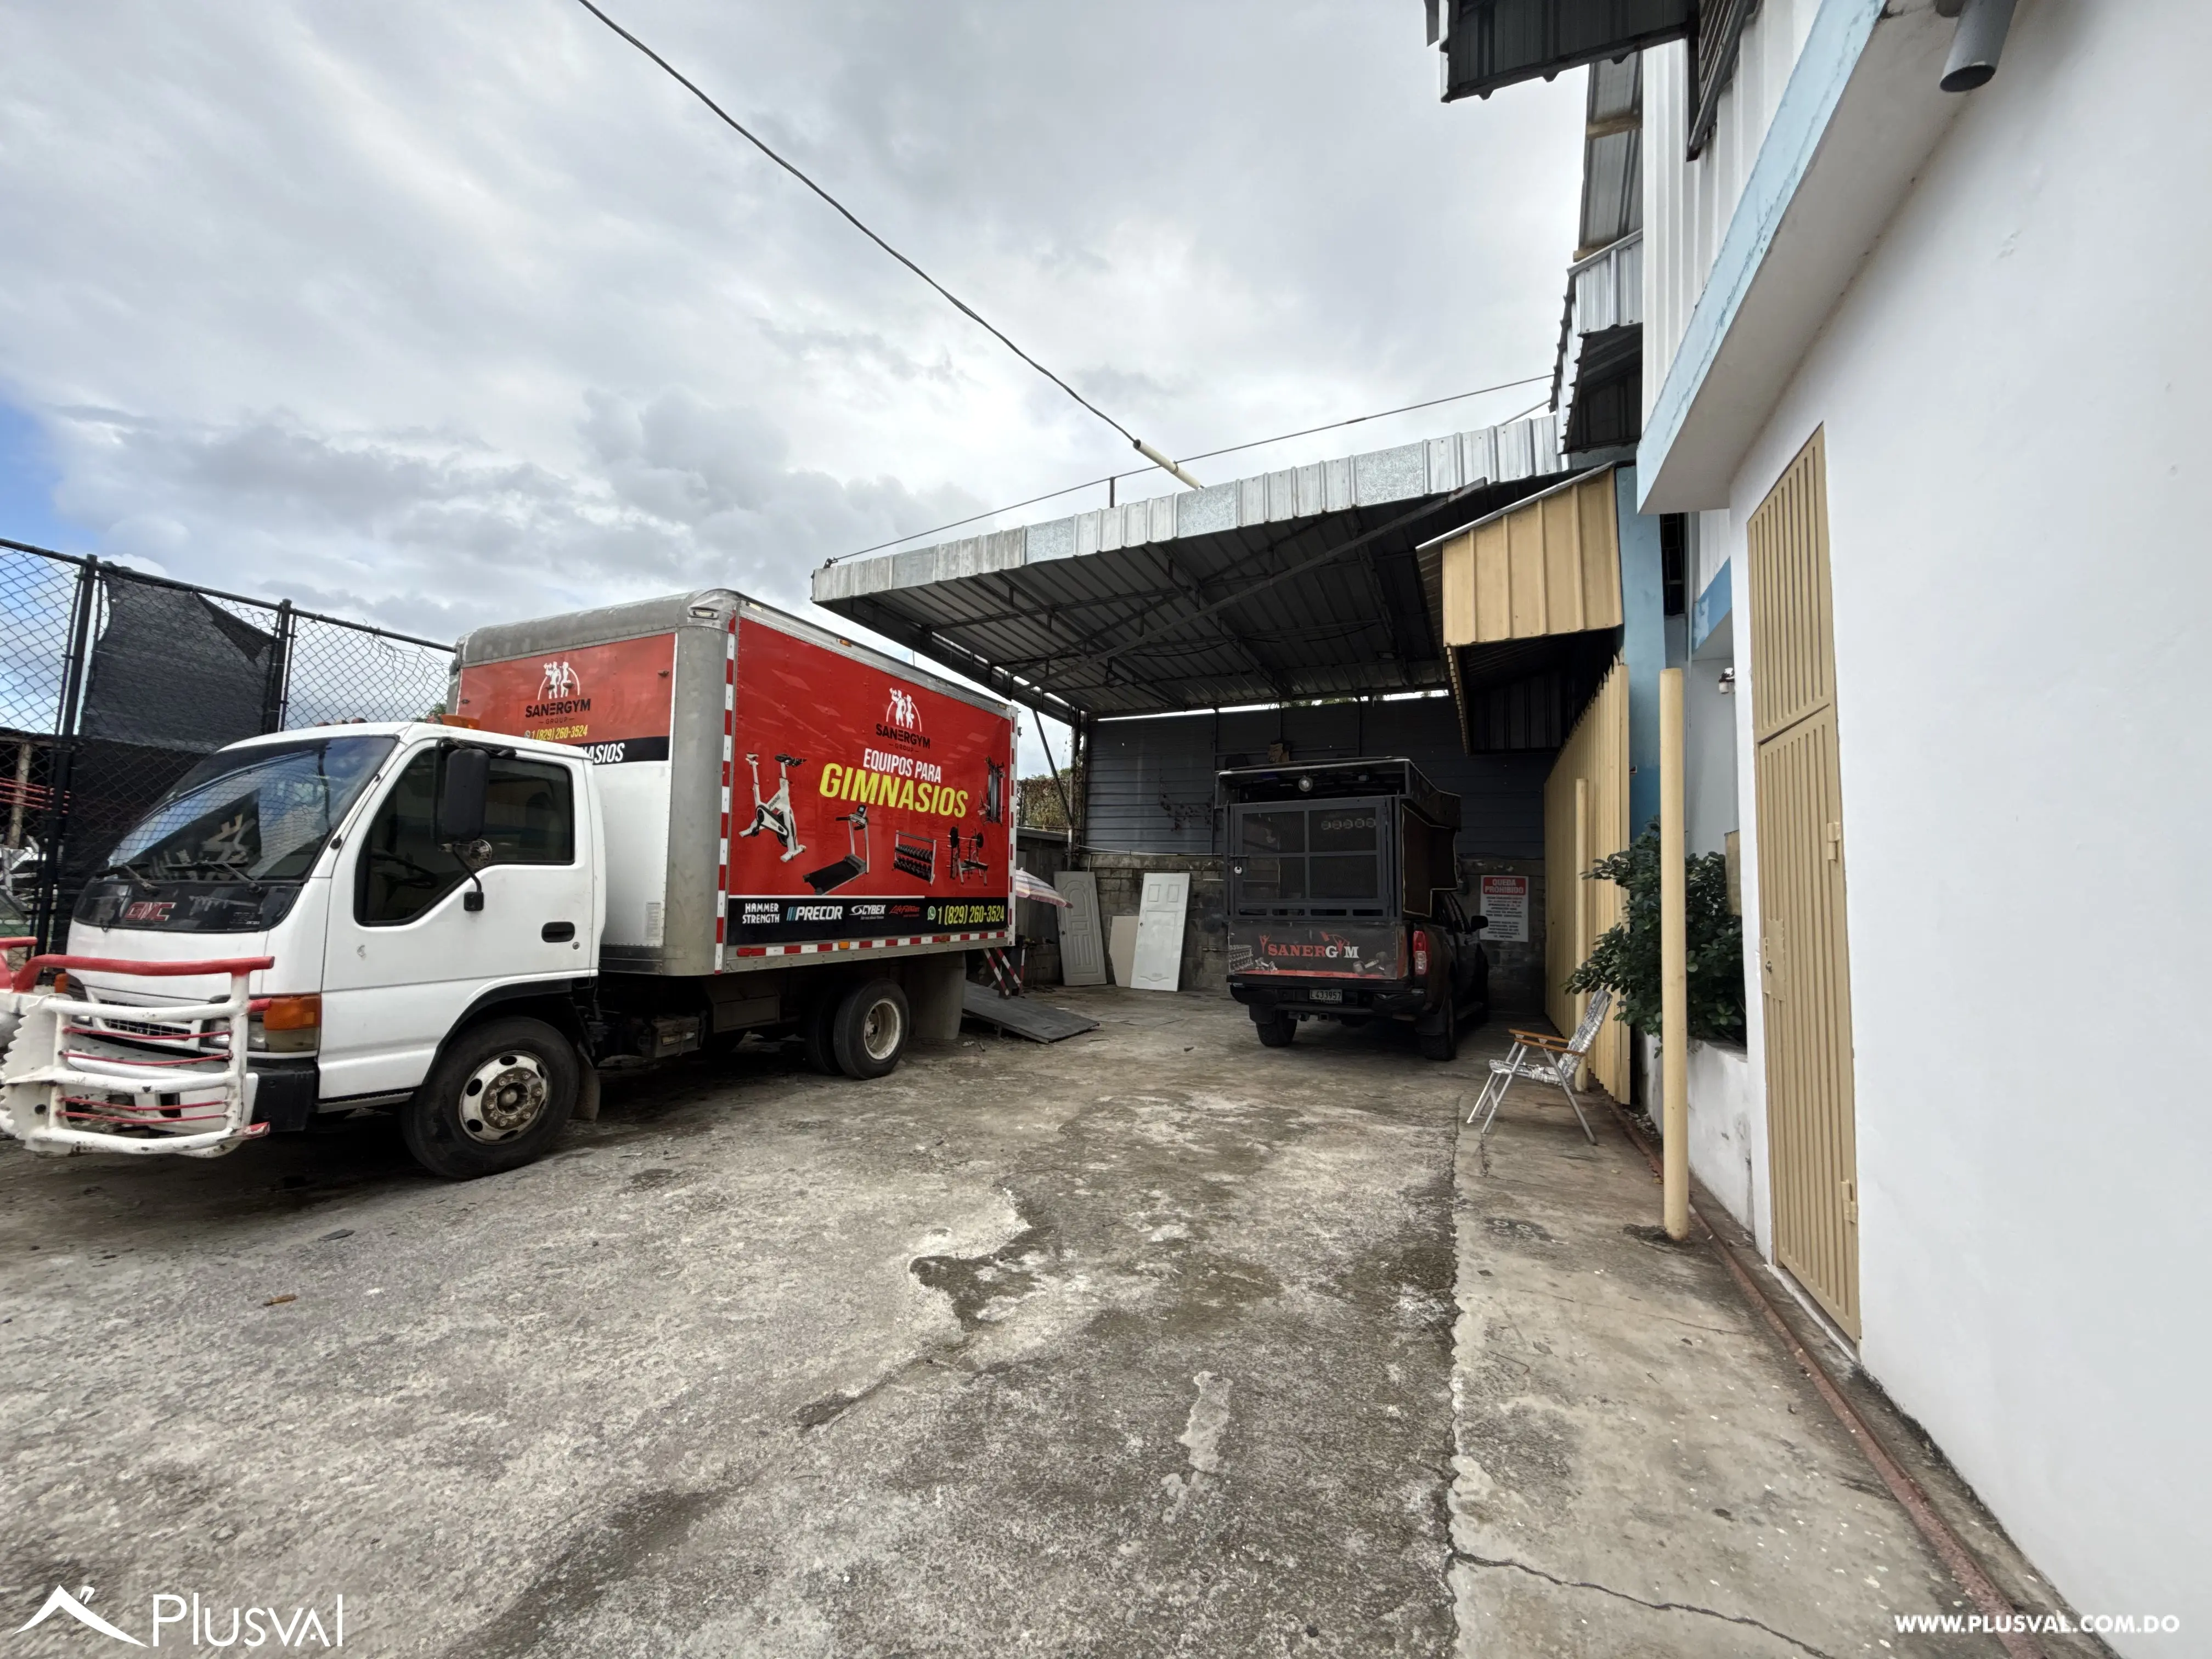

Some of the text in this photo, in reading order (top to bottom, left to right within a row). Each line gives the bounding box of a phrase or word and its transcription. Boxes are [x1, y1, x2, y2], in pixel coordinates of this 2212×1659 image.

[525, 698, 591, 718] SANERGYM
[537, 727, 555, 741] (829)
[555, 725, 589, 740] 260-3524
[876, 724, 930, 749] SANERGYM
[894, 743, 915, 753] GROUP
[863, 748, 941, 783] EQUIPOS PARA
[819, 763, 968, 818] GIMNASIOS
[124, 902, 177, 922] GMC
[744, 903, 779, 913] HAMMER
[794, 906, 843, 921] PRECOR
[938, 905, 1005, 926] 1 (829) 260-3524
[742, 913, 781, 924] STRENGTH
